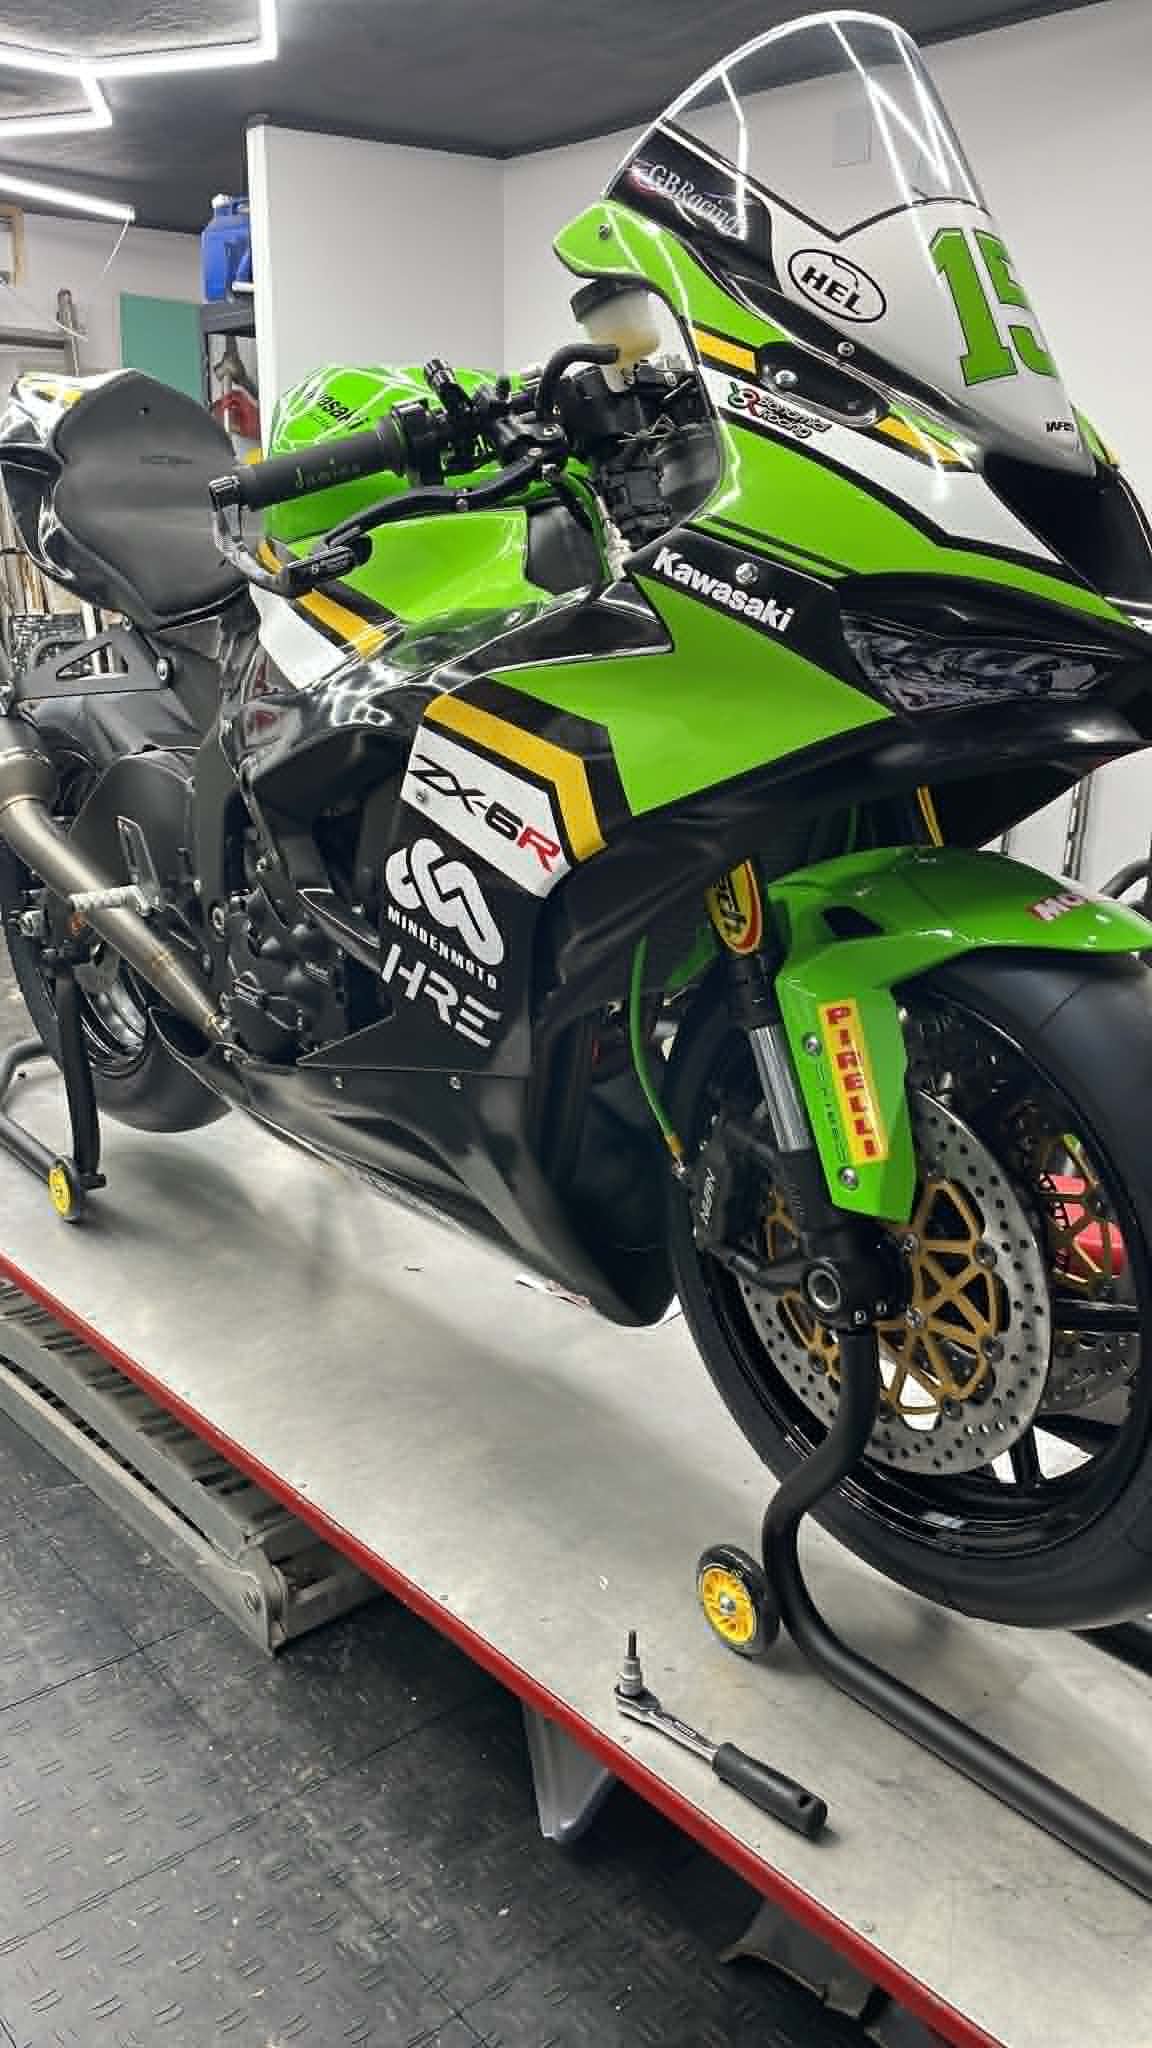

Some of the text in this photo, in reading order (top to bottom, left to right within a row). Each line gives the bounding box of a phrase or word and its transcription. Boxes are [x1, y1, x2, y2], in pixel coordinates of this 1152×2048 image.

[801, 266, 861, 315] HEL
[652, 547, 796, 632] Kawasaki
[408, 754, 561, 873] ZX-6R
[381, 943, 501, 1047] HRE
[387, 904, 498, 991] MINDENMOTO
[826, 1006, 880, 1157] PIRELLI
